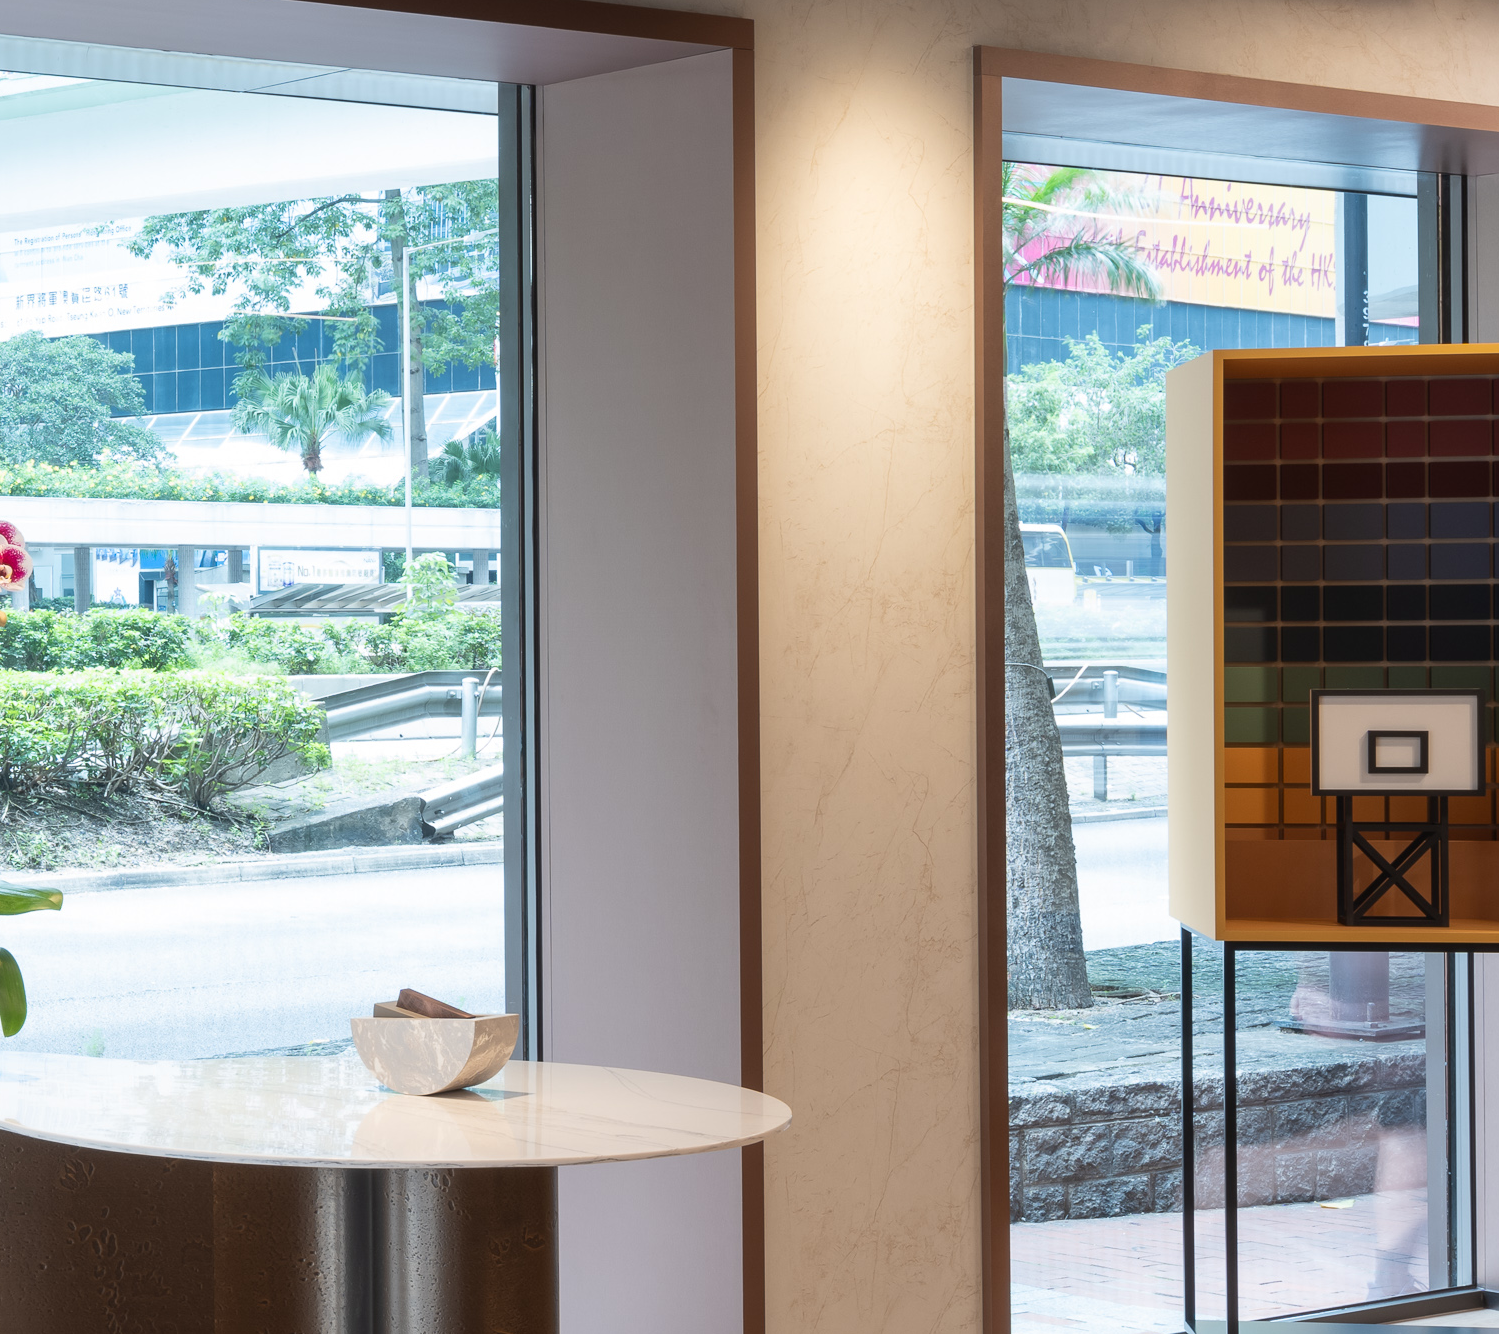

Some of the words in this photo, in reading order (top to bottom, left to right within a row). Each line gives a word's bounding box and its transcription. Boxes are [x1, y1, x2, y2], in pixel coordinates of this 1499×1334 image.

[1178, 177, 1311, 252] Anniversary
[1134, 229, 1252, 281] Establishment
[1258, 246, 1275, 296] of
[1281, 250, 1305, 287] the
[1311, 252, 1336, 291] HK
